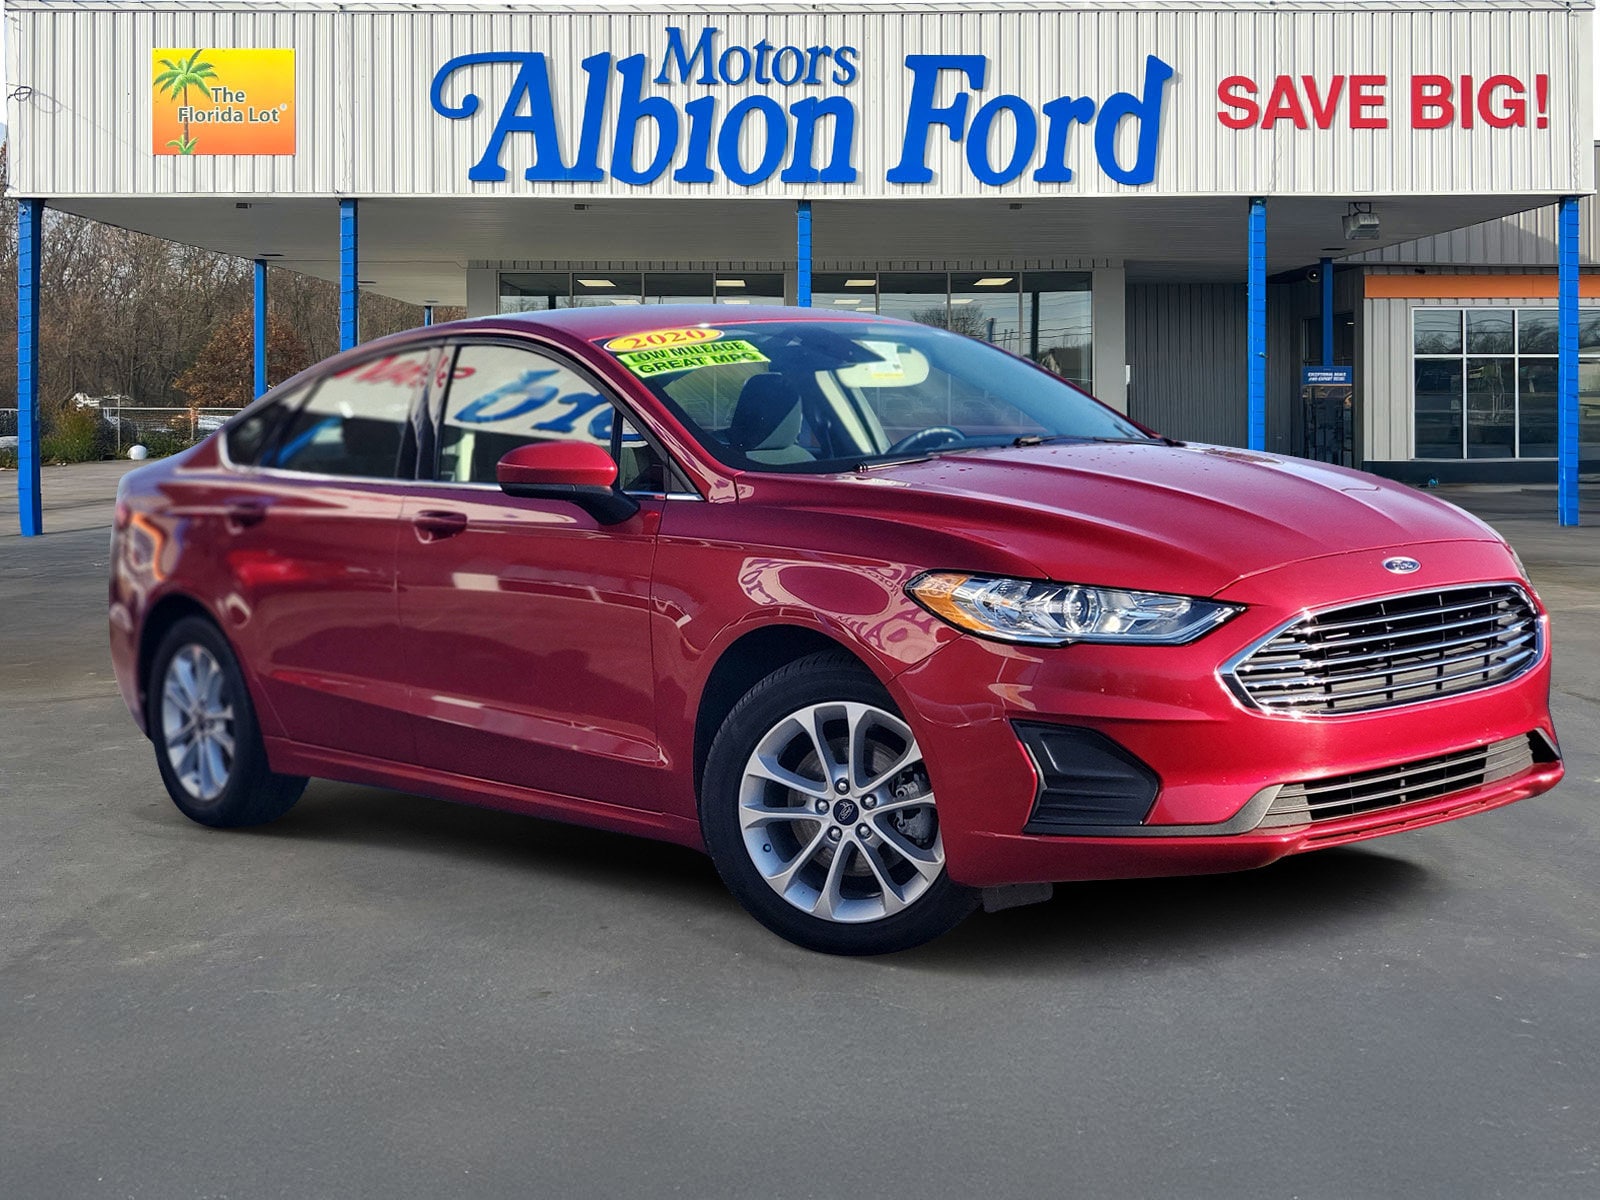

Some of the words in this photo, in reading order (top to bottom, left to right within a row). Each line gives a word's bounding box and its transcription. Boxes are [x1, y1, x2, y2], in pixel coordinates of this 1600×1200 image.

[654, 27, 857, 85] Motors
[210, 87, 246, 103] The
[1217, 75, 1388, 129] SAVE
[1411, 75, 1548, 129] BIG!
[177, 106, 244, 123] Florida
[248, 106, 279, 123] Lot
[430, 52, 857, 186] Albion
[886, 55, 1174, 186] Ford
[624, 330, 707, 349] 2020
[628, 347, 666, 363] LOW
[668, 341, 745, 357] MILEAGE
[639, 357, 704, 374] GREAT
